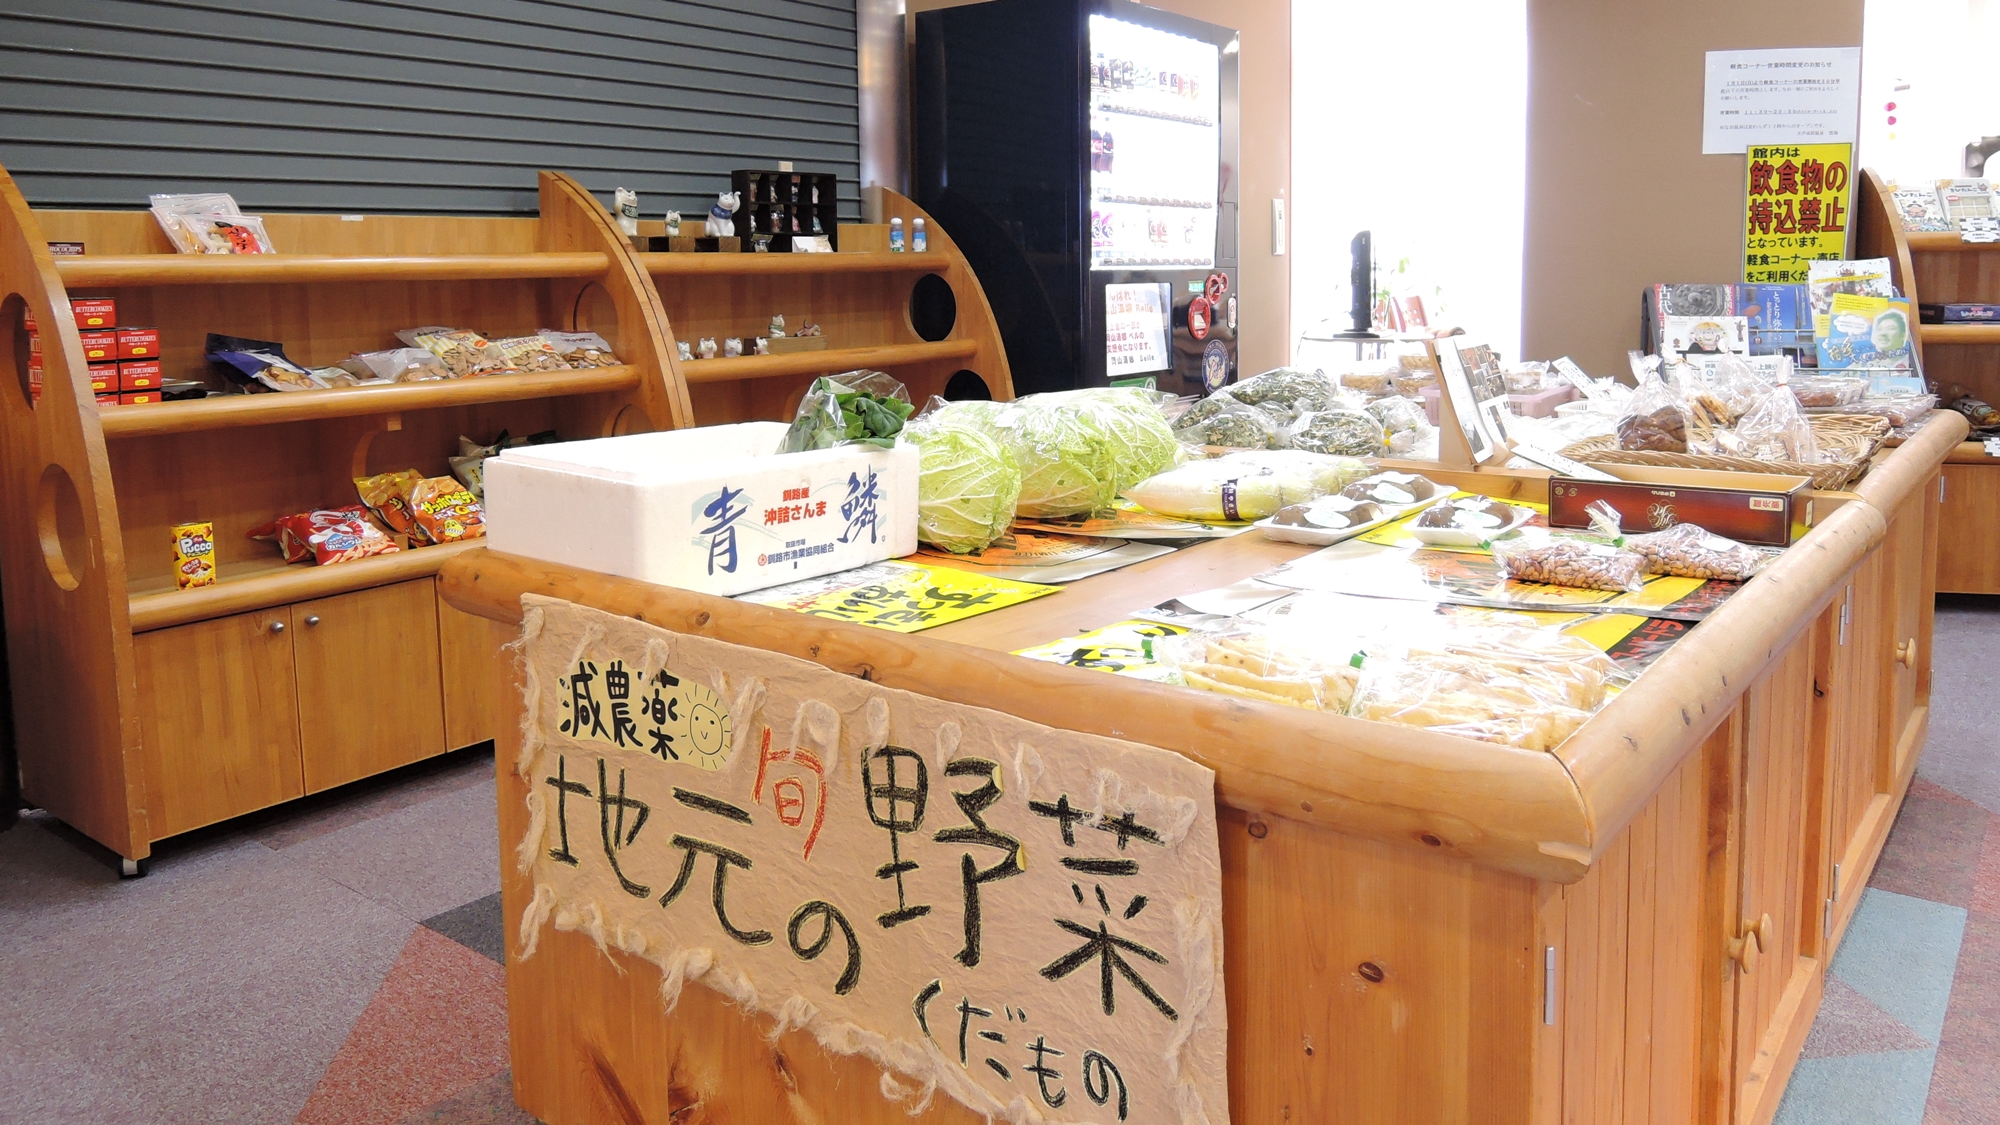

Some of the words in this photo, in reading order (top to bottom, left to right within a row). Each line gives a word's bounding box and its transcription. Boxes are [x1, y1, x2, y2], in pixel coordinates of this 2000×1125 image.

[1752, 147, 1801, 159] 館内は
[1749, 158, 1848, 196] 飲食物の
[1748, 196, 1845, 235] 持込禁止
[1747, 236, 1824, 249] となっています。
[764, 500, 827, 526] 沖詰さんま
[782, 486, 810, 502] 釧路産
[700, 484, 749, 576] 青
[767, 542, 835, 565] 釧路市漁業協同組合
[559, 660, 680, 762] 減農薬
[752, 725, 828, 862] 旬
[912, 978, 1130, 1123] くだもの
